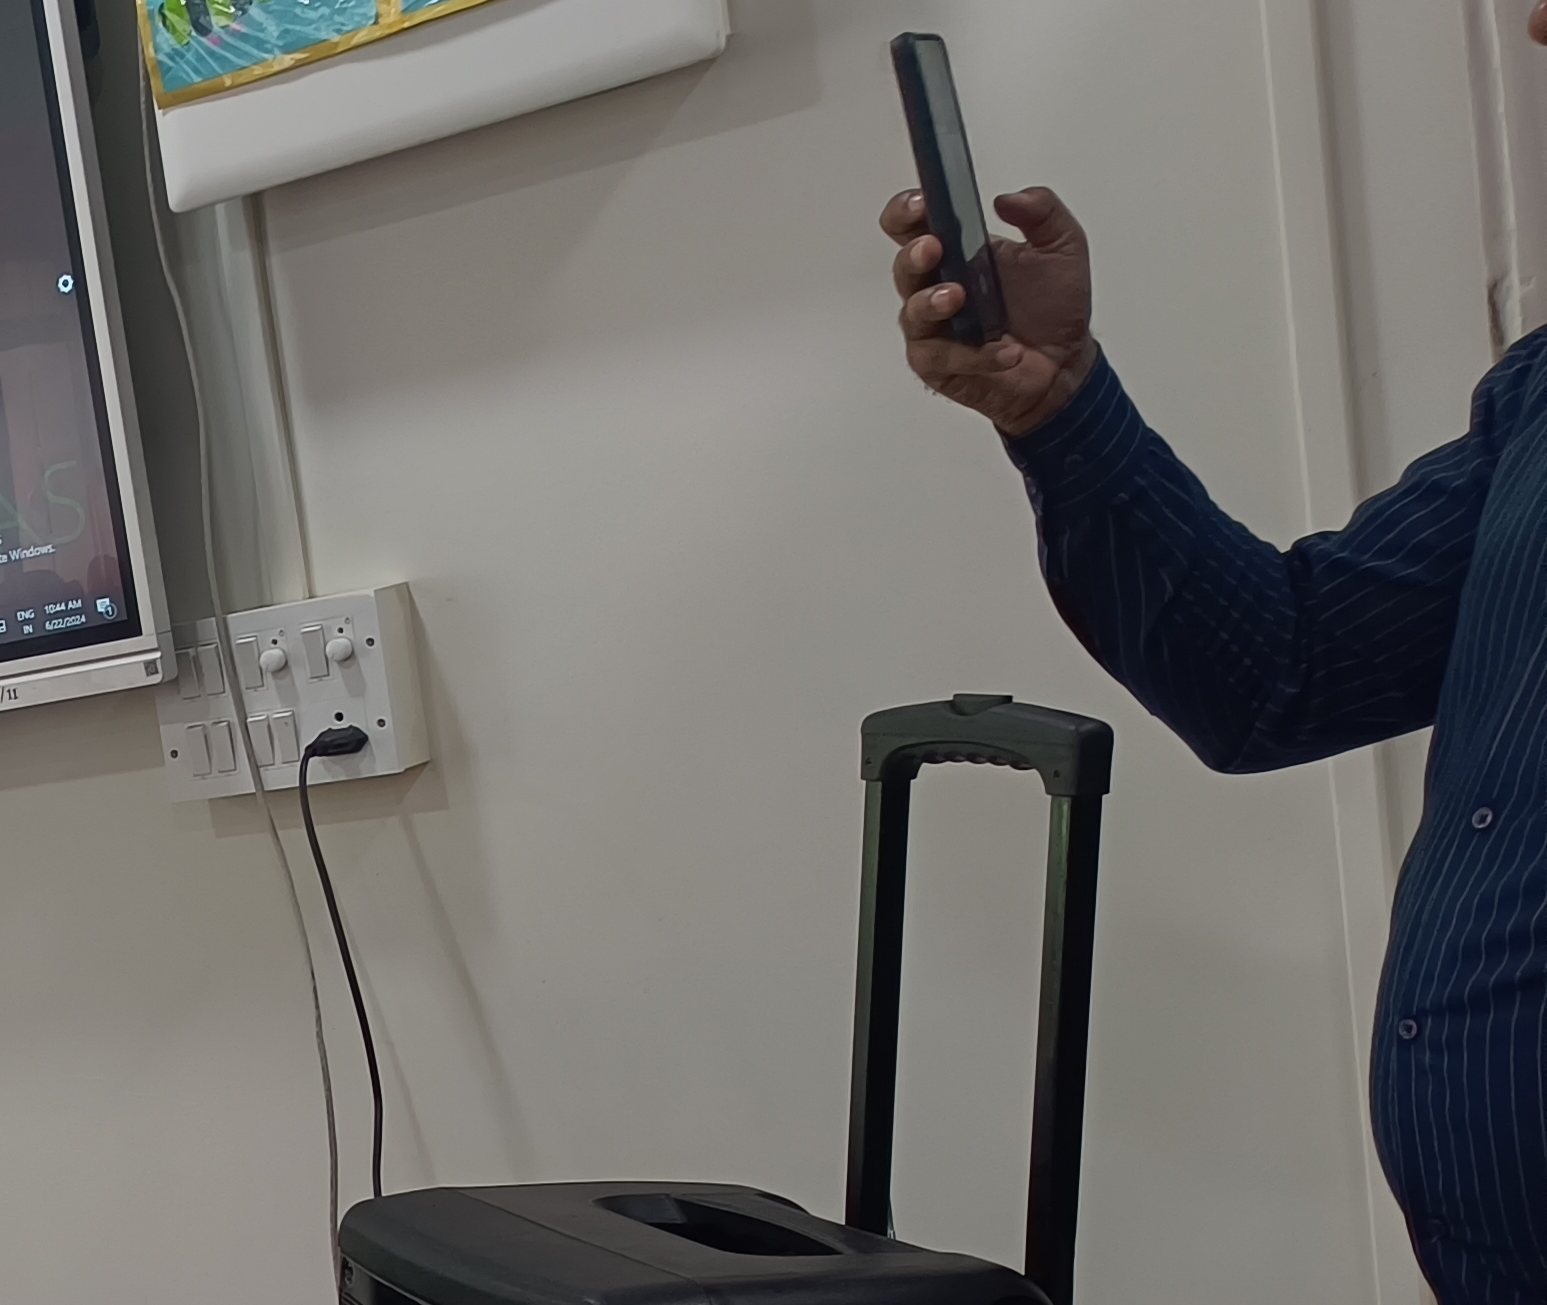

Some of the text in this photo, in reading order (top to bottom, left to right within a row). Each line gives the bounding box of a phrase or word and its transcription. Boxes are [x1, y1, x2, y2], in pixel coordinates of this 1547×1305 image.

[44, 599, 82, 615] 10:44 AM
[17, 609, 35, 621] ENG
[23, 624, 33, 634] IN
[45, 614, 86, 631] 6/22/2024
